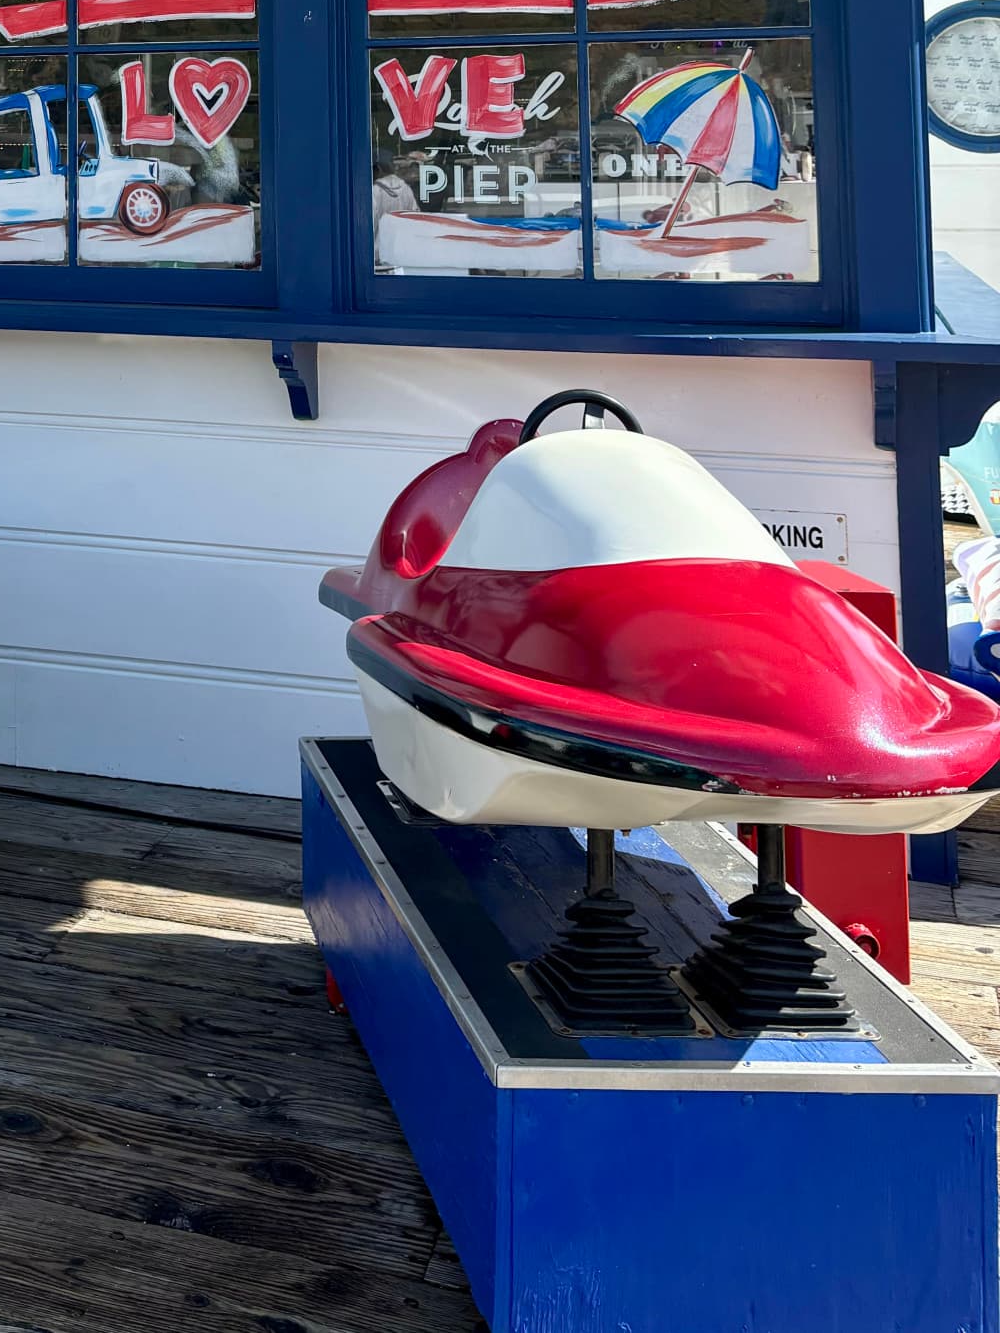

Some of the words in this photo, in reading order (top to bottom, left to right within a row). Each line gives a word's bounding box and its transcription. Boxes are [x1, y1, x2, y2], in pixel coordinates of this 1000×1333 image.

[451, 145, 464, 154] AT
[490, 145, 511, 154] THE
[419, 164, 539, 205] PIER
